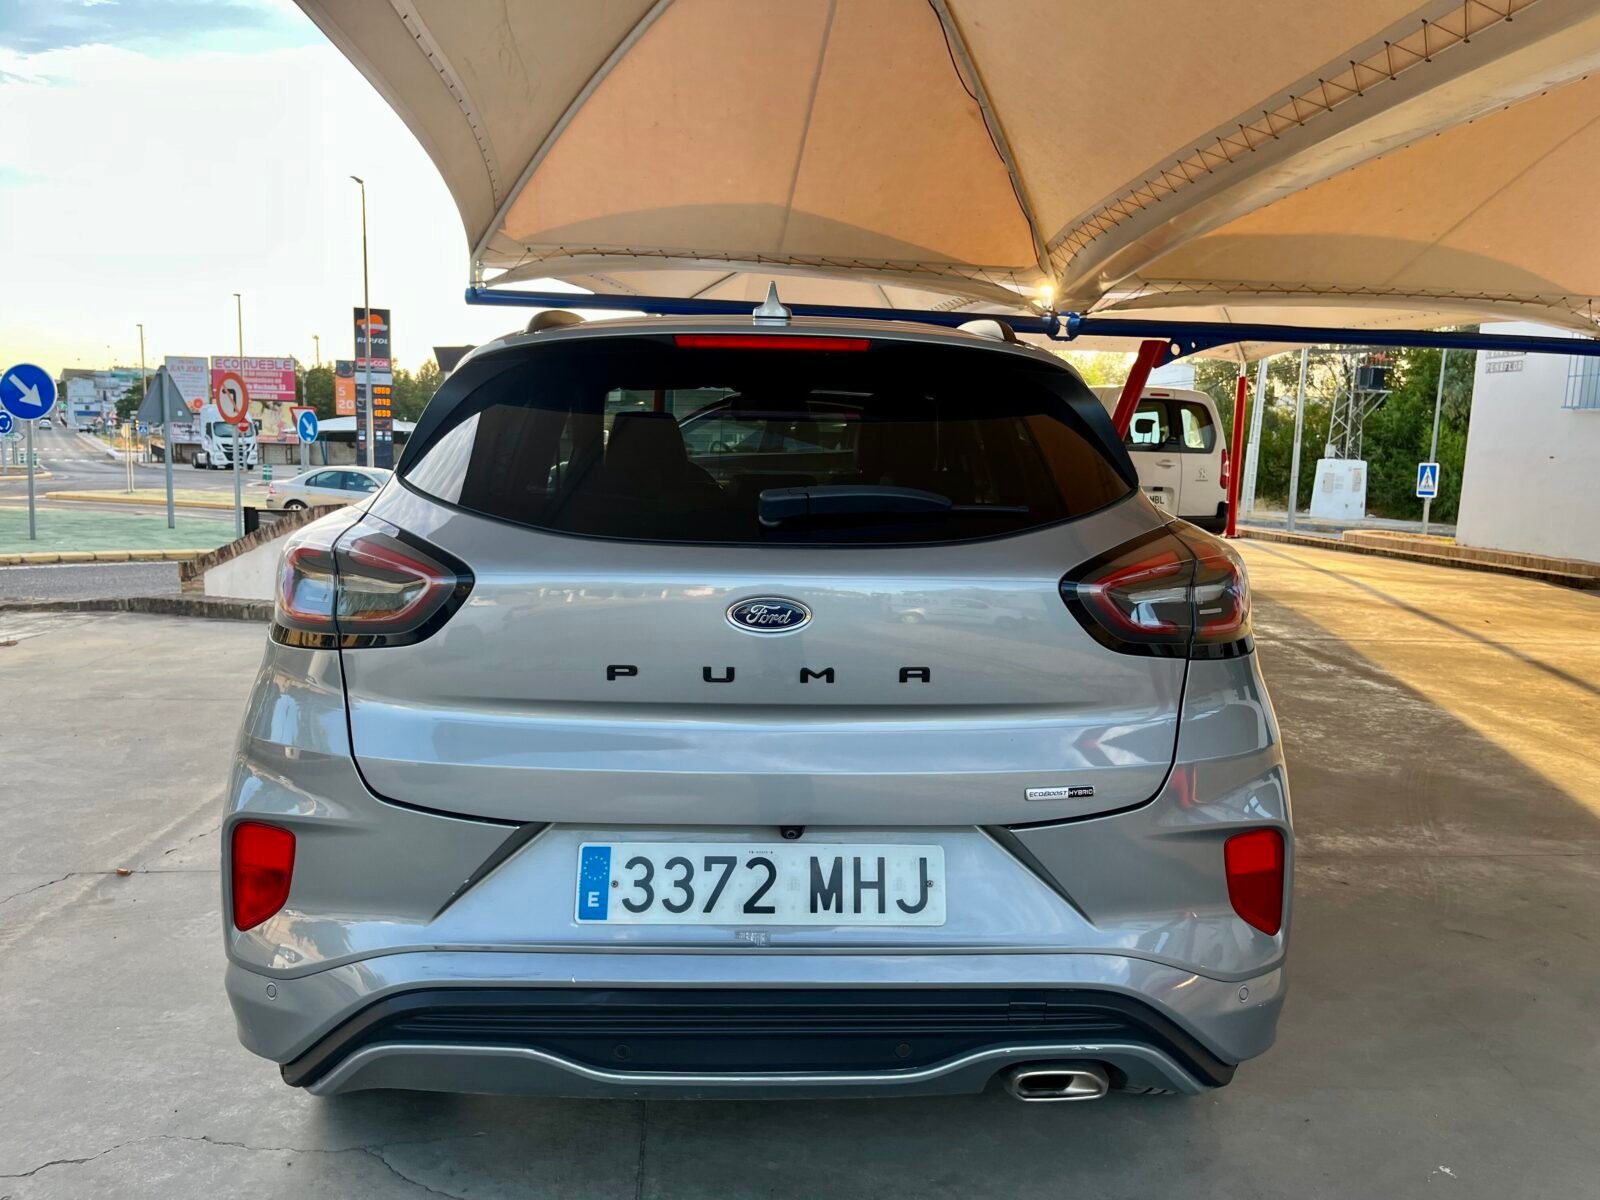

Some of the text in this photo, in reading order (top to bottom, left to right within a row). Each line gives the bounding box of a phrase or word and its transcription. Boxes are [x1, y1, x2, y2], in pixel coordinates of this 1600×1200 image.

[746, 604, 792, 624] Ford
[606, 664, 931, 684] PUMA
[1068, 788, 1093, 797] HYBRID
[621, 856, 928, 914] 3372 MHJ
[587, 891, 600, 907] E
